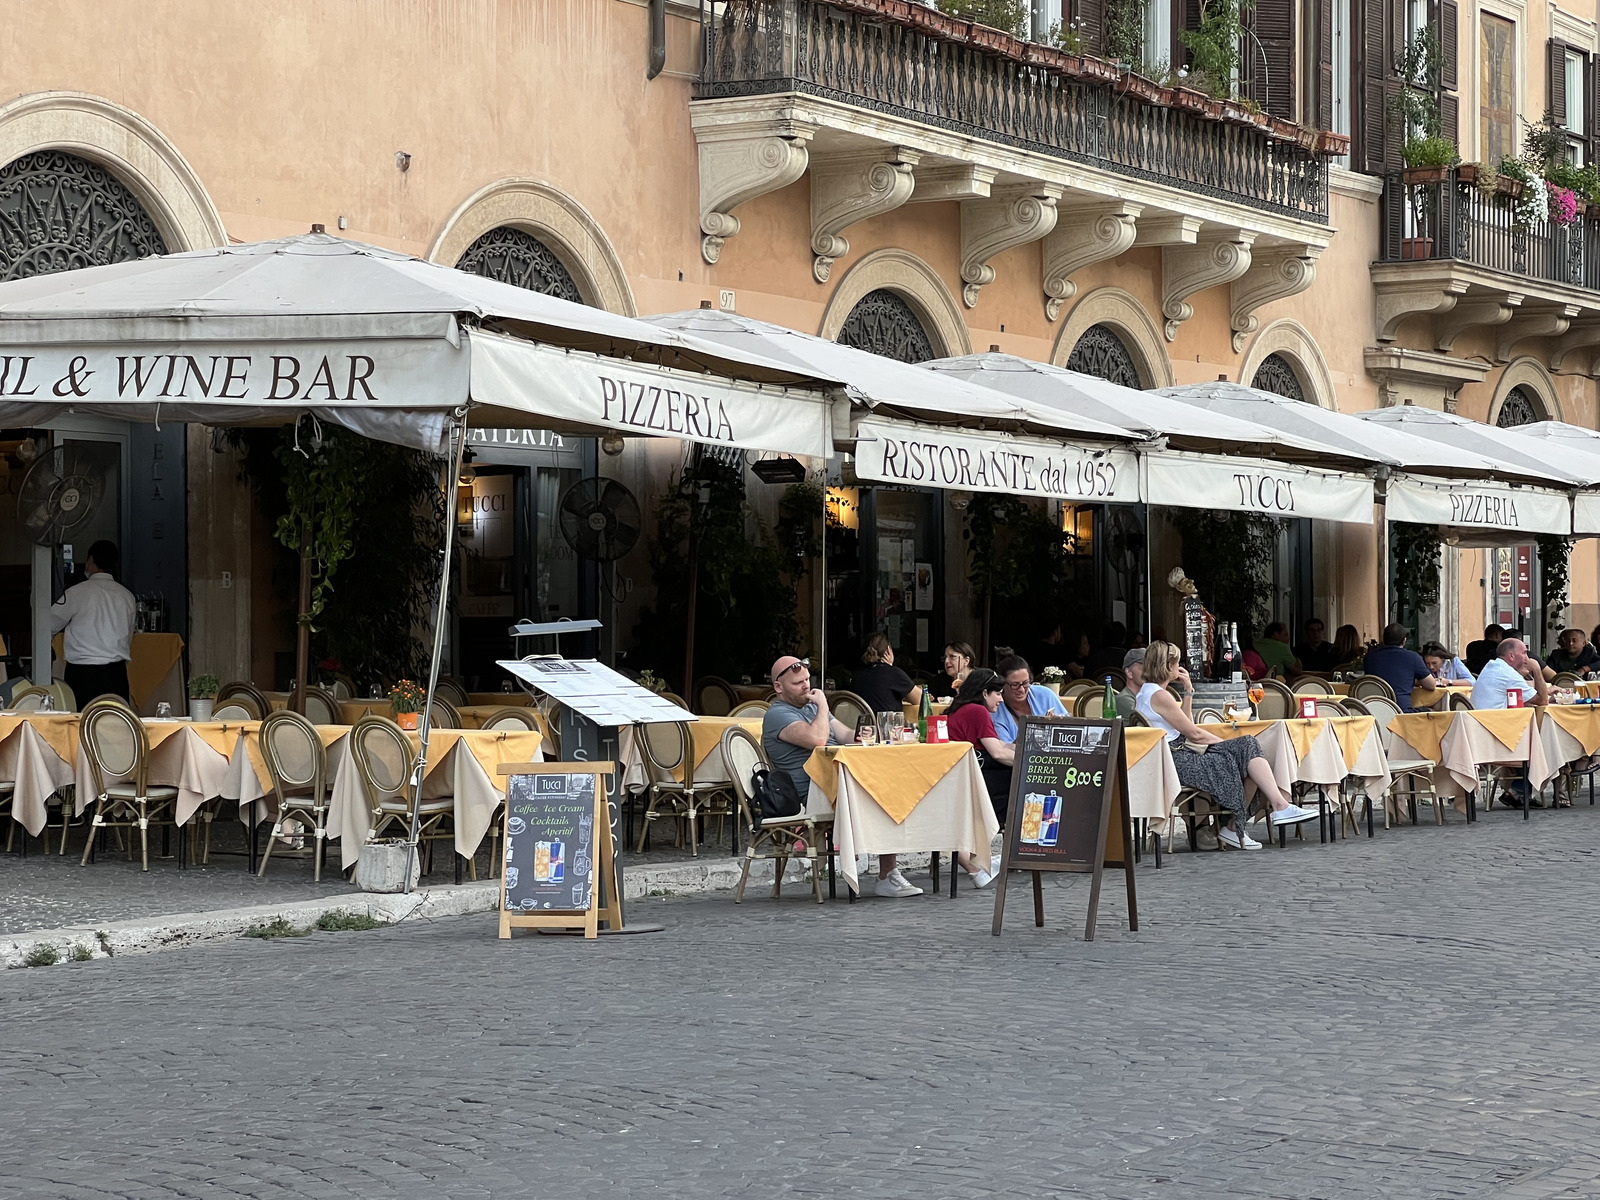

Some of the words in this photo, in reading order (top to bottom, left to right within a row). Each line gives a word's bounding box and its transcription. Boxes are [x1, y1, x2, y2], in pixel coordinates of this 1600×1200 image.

[720, 291, 733, 308] 97
[51, 355, 96, 397] &
[115, 354, 252, 399] WINE
[263, 354, 378, 400] BAR
[598, 376, 736, 442] PIZZERIA
[881, 437, 1037, 491] RISTORANTE
[1039, 457, 1069, 495] dal
[1076, 460, 1117, 496] 1952
[1232, 474, 1296, 512] TUCCI
[462, 494, 506, 513] TUCCI
[1448, 493, 1519, 527] PIZZERIA
[1028, 755, 1073, 766] COCKTAIL
[1027, 765, 1055, 774] BIRRA
[1026, 775, 1058, 785] SPRITZ
[513, 804, 538, 814] Coffee
[558, 804, 585, 813] Cream
[530, 816, 569, 825] Cocktails
[541, 827, 574, 837] Aperitif
